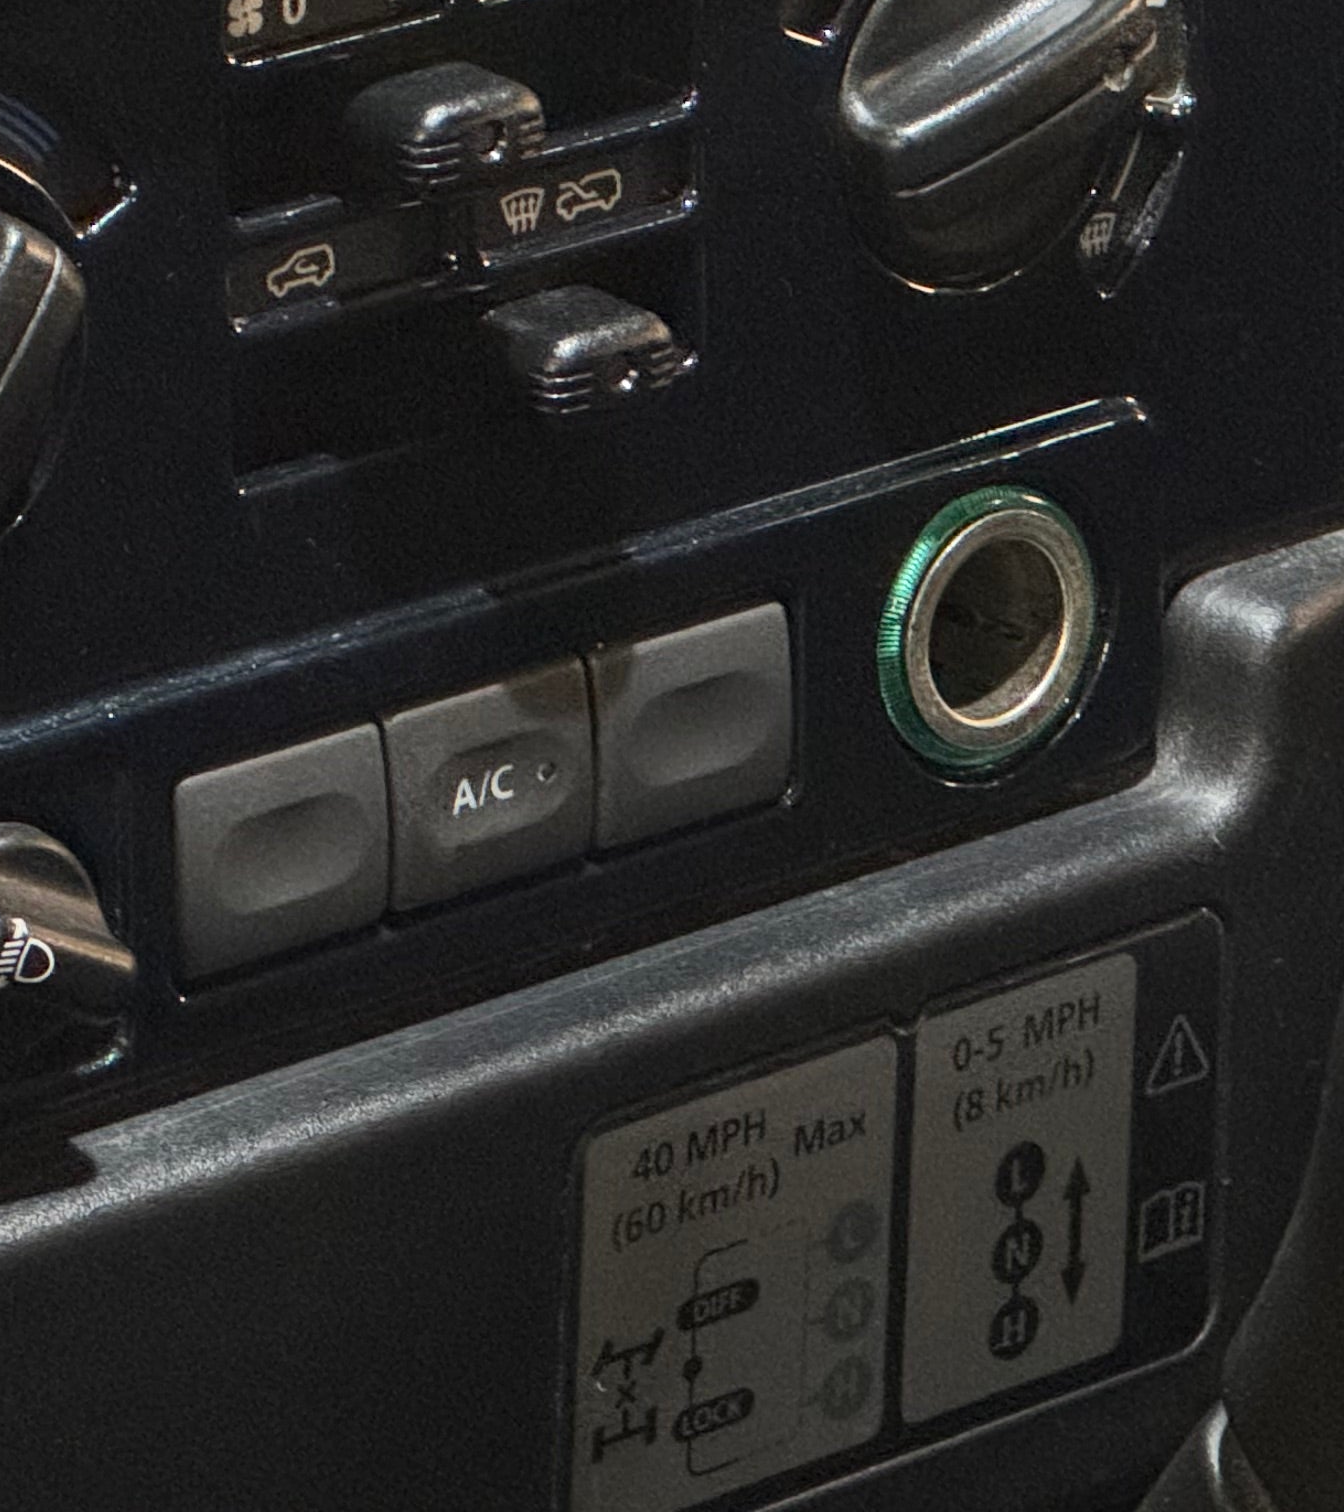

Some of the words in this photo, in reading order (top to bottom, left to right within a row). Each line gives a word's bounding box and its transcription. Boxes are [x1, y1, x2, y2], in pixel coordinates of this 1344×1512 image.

[452, 763, 515, 818] A/C
[952, 1024, 1005, 1072] 0-5
[1022, 990, 1101, 1049] MPH
[953, 1088, 985, 1133] (8
[995, 1047, 1095, 1113] km/h)
[632, 1141, 674, 1182] 40
[685, 1109, 766, 1166] MPH
[793, 1111, 867, 1157] Max
[611, 1200, 667, 1254] (60
[678, 1157, 781, 1224] km/h)
[1005, 1232, 1030, 1271] N
[693, 1285, 743, 1323] DIFF
[1002, 1309, 1027, 1346] H
[681, 1392, 745, 1436] LOCK
